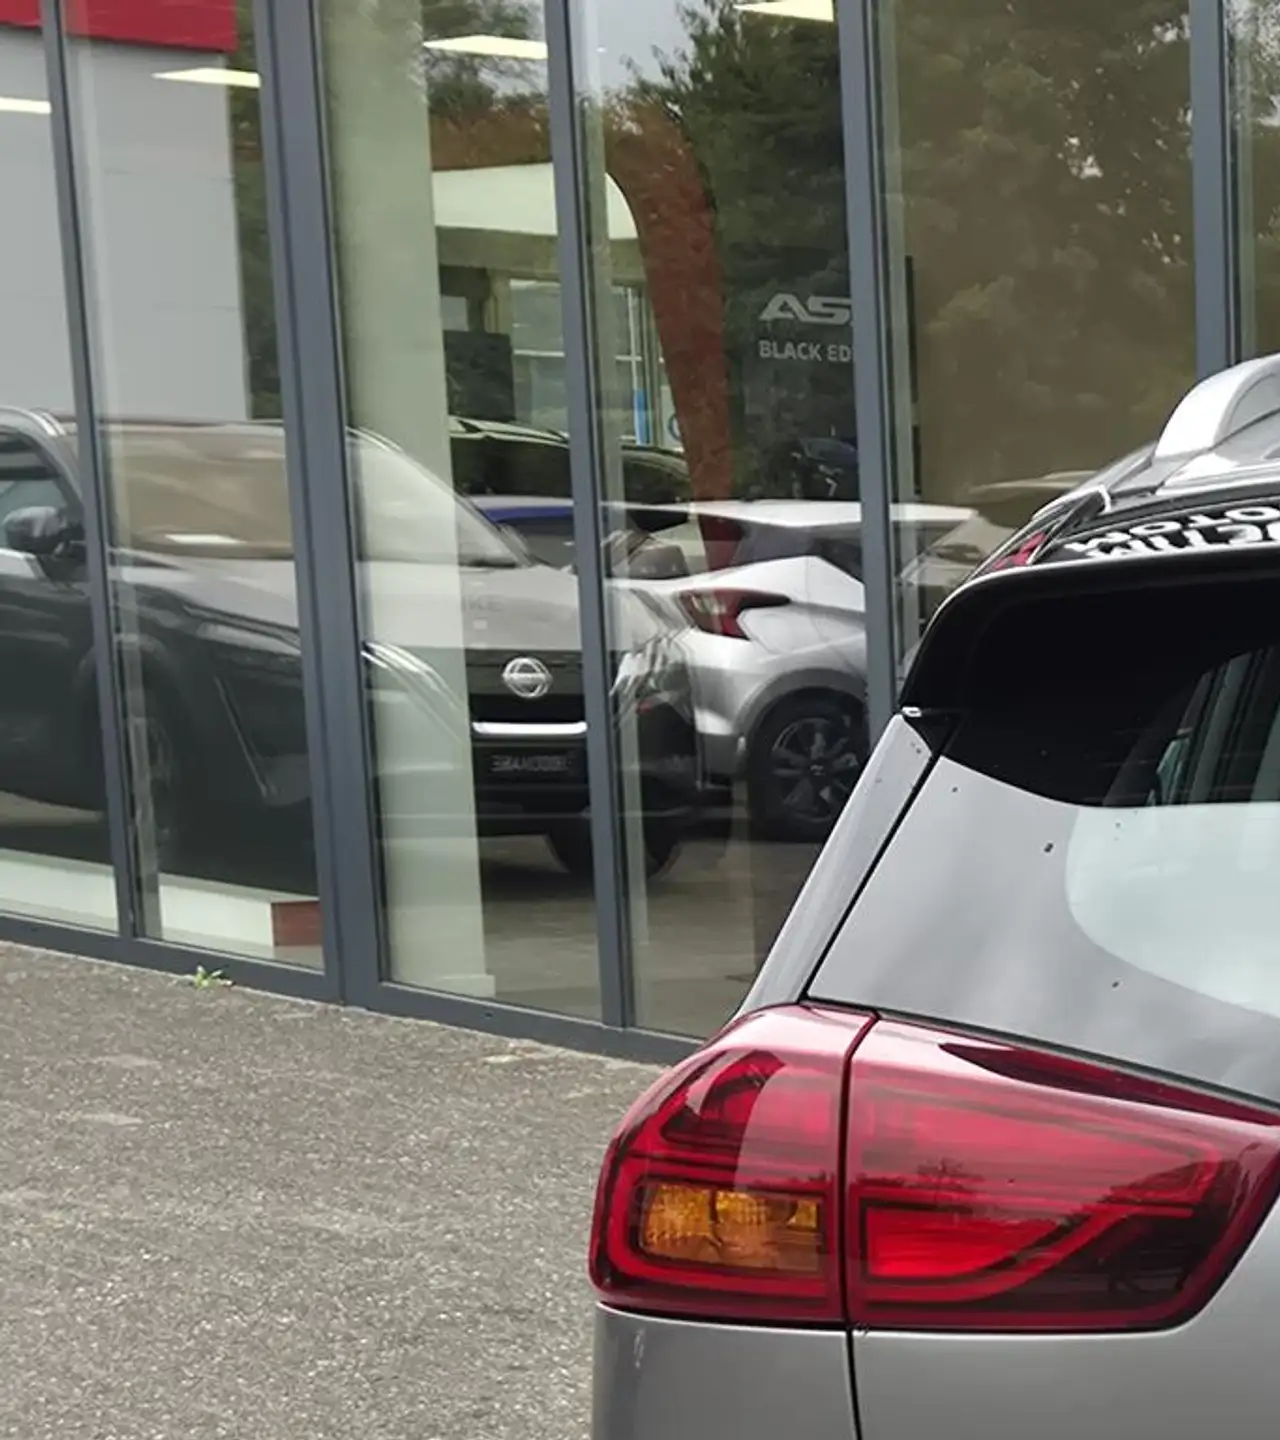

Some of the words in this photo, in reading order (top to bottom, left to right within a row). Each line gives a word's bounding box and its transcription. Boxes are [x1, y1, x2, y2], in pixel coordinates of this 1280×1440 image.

[759, 293, 851, 325] AS
[759, 340, 822, 361] BLACK
[827, 344, 851, 362] ED
